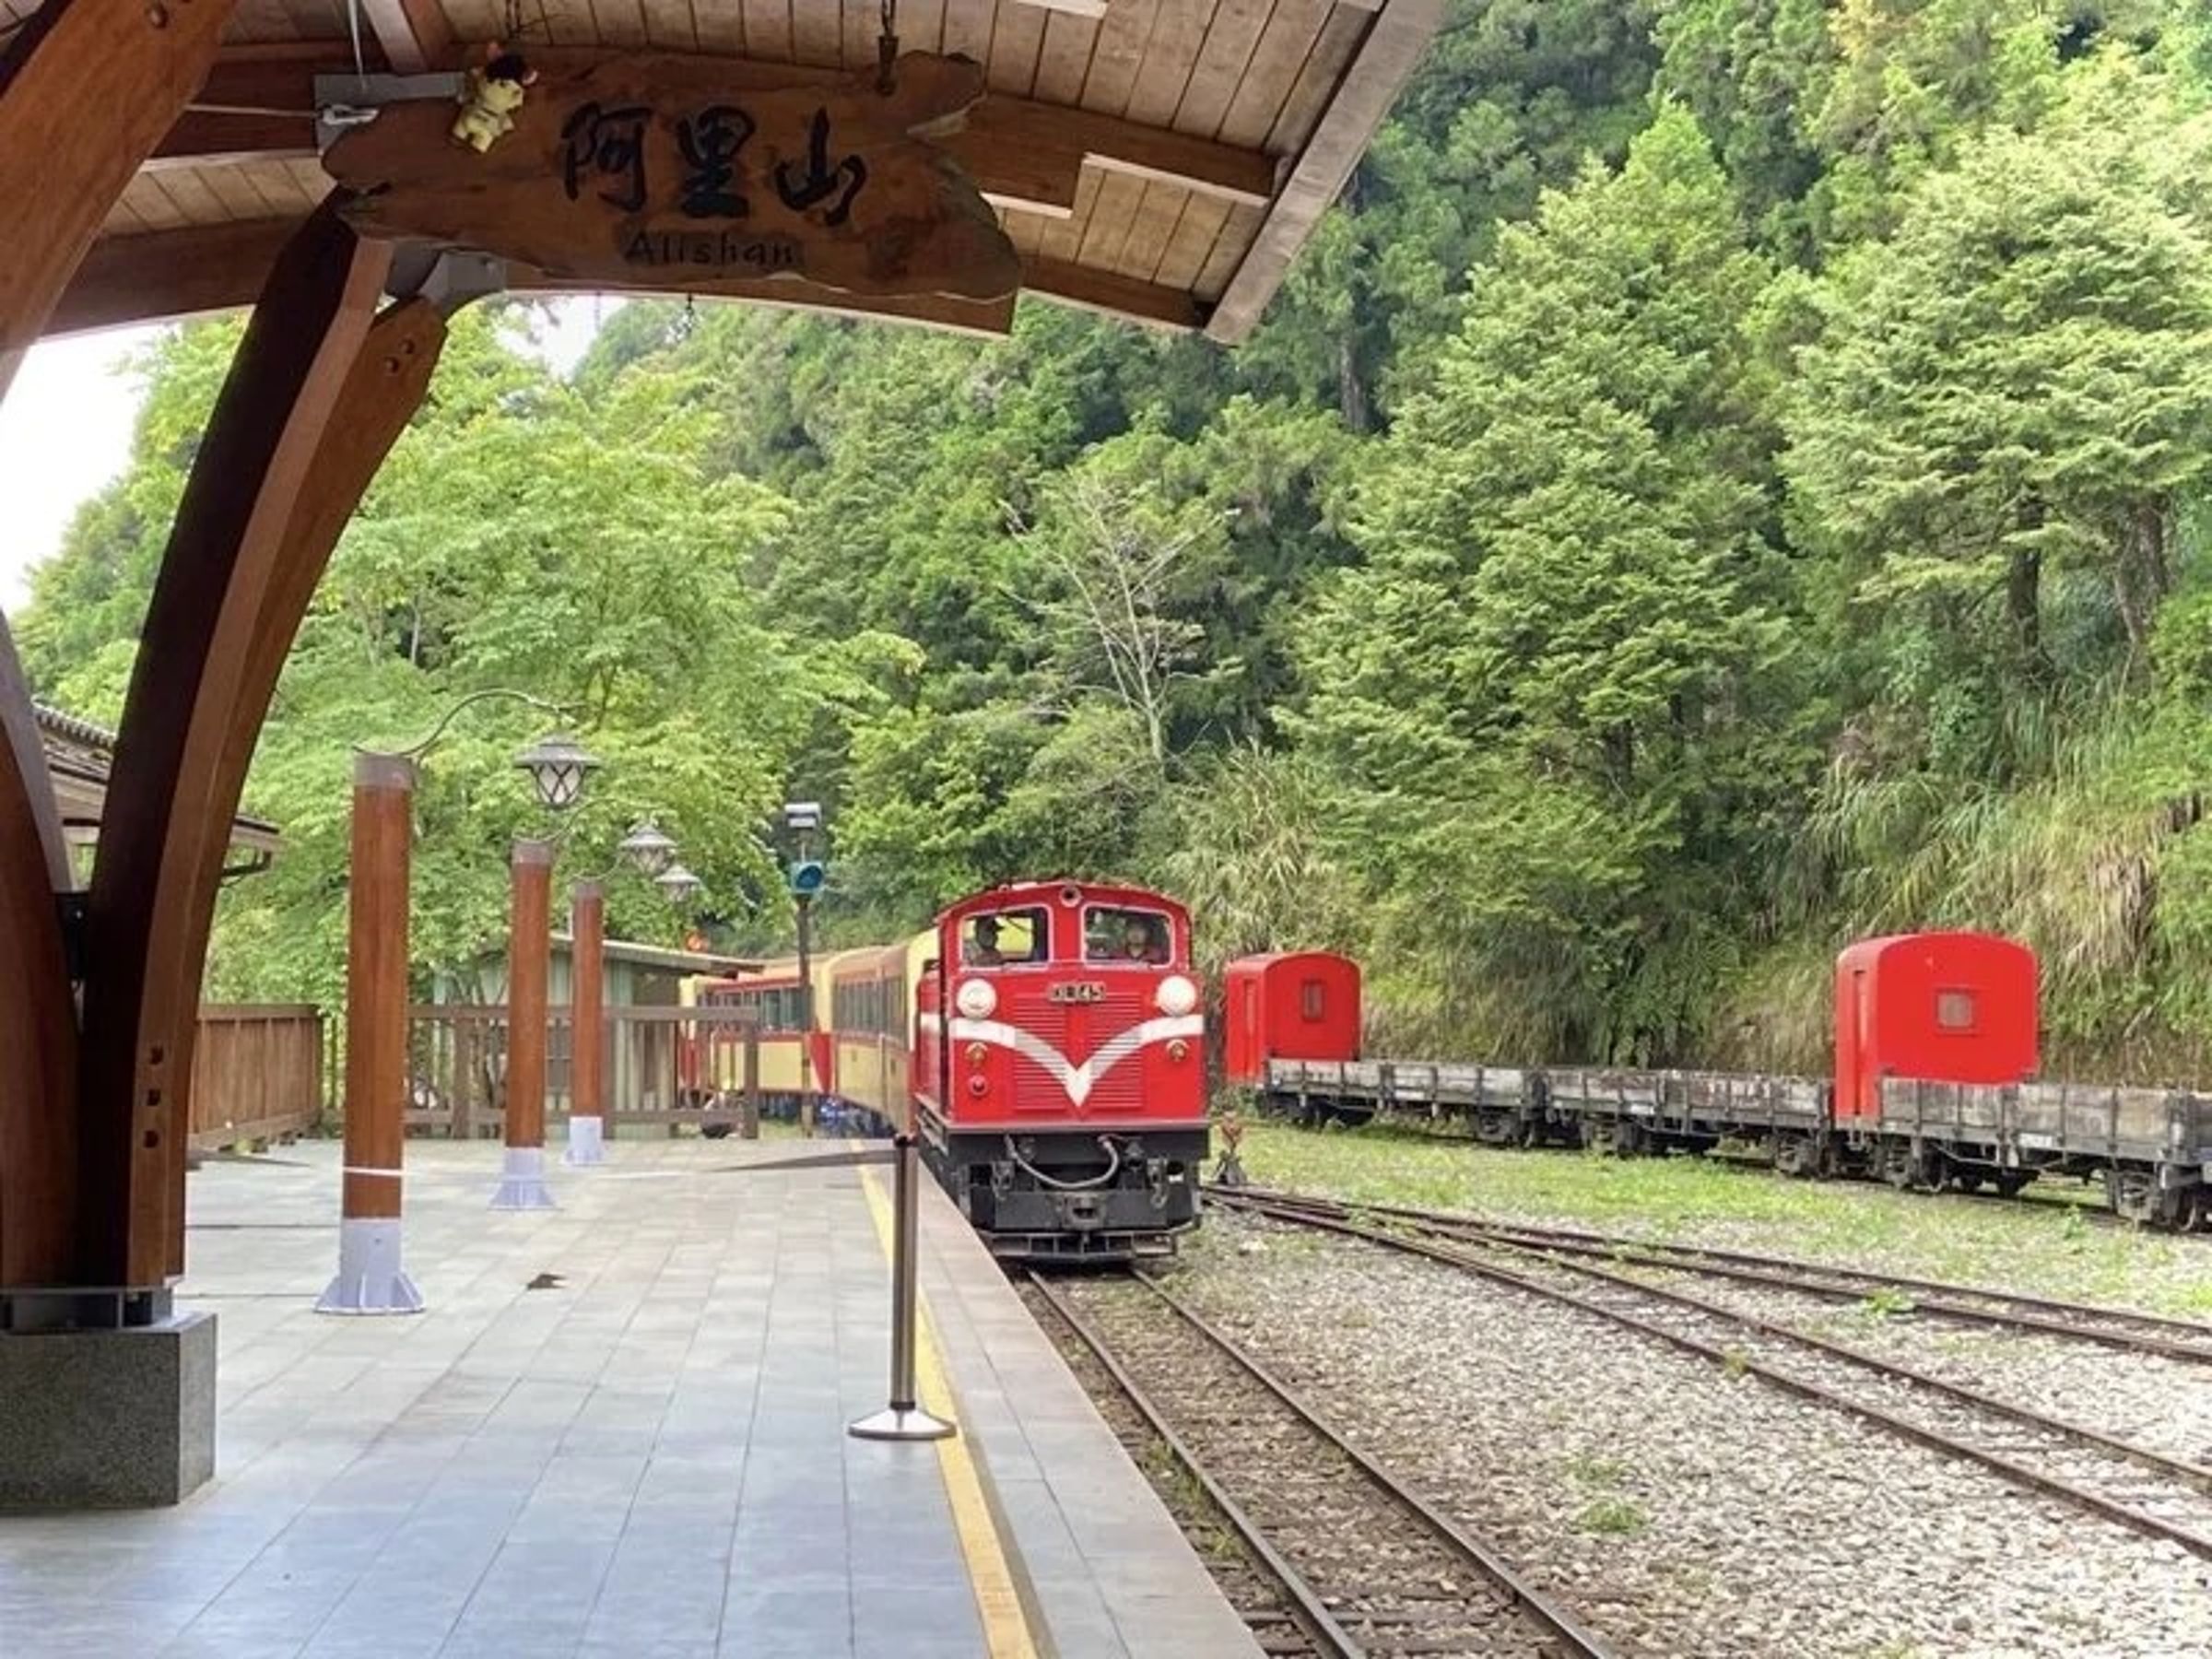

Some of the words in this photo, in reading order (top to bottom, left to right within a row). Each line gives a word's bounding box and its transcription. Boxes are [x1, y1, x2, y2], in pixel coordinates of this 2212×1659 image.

[561, 101, 868, 227] 阿里山
[624, 231, 794, 265] Alishan
